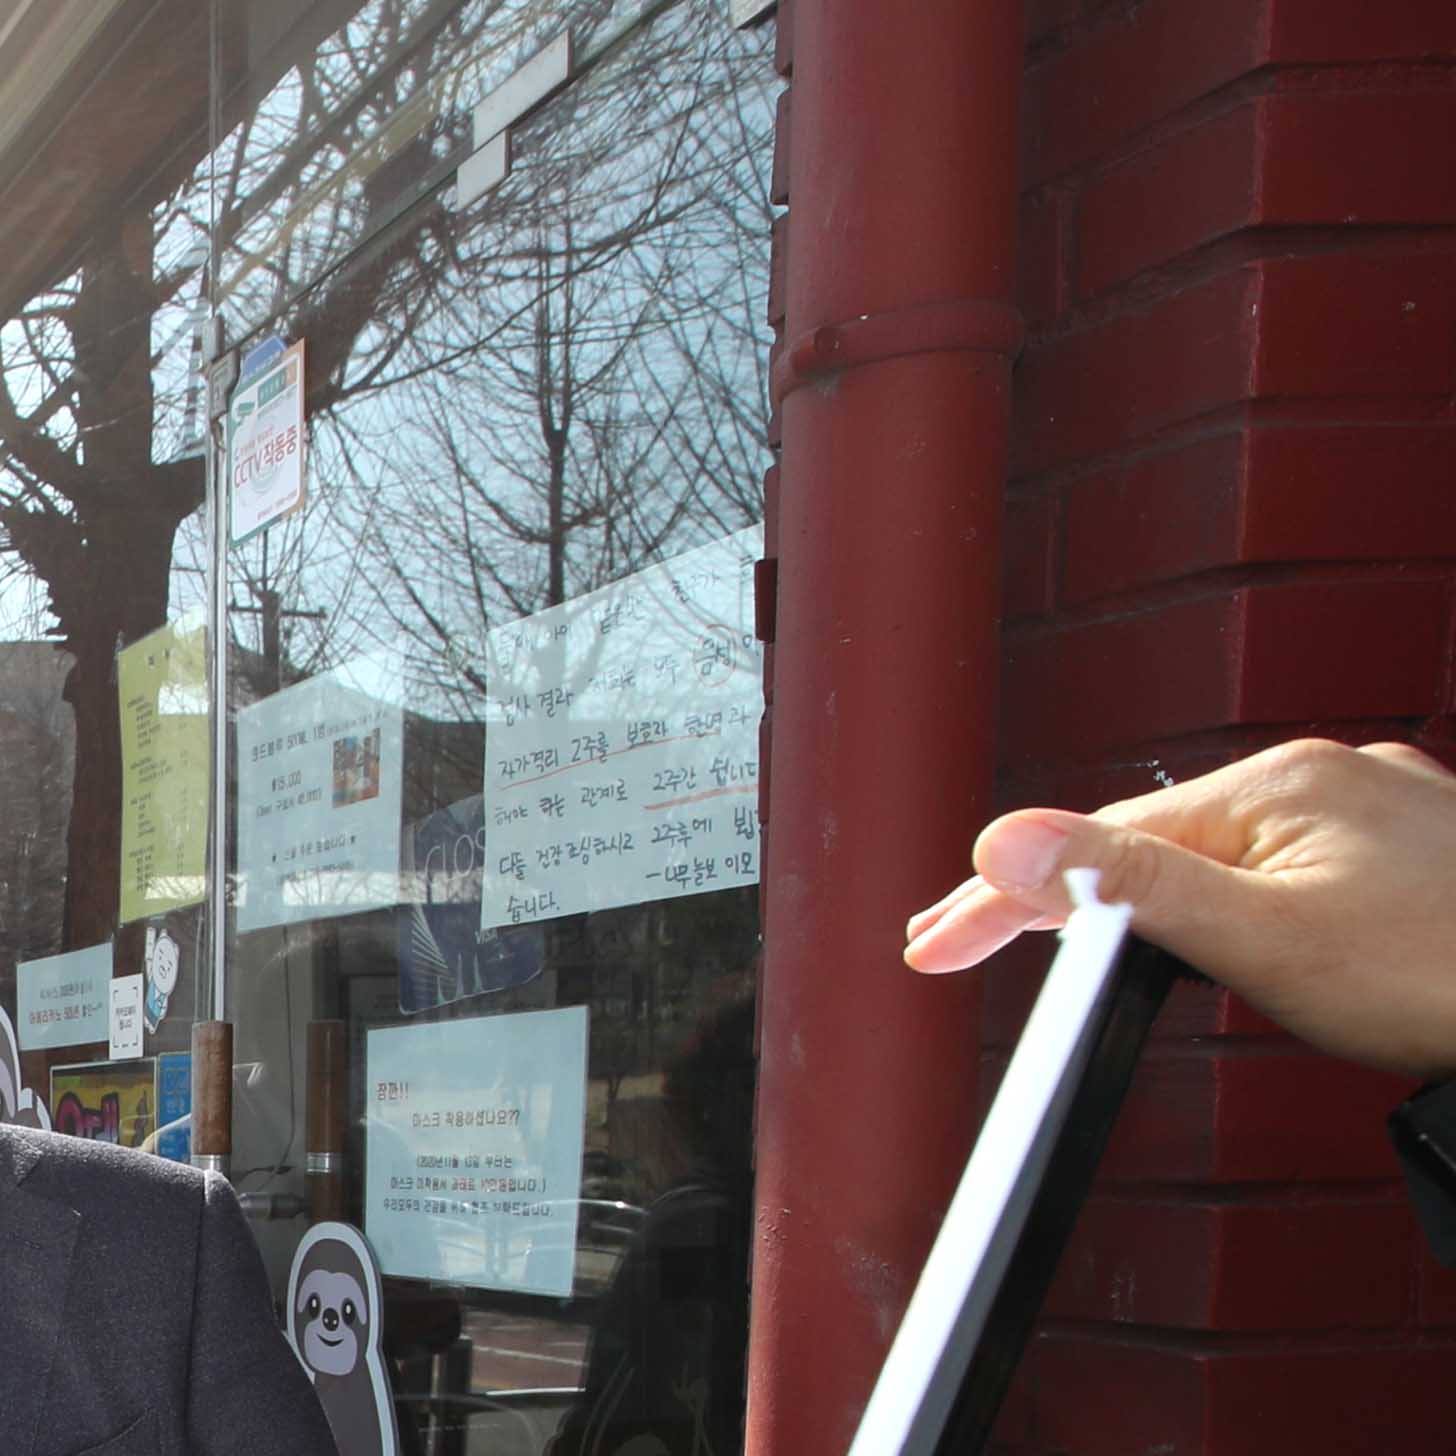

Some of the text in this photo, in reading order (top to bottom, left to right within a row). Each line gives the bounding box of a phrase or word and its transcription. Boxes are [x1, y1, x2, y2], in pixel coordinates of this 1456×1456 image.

[234, 451, 263, 489] CCTV
[264, 425, 298, 466] 작동중
[539, 690, 576, 718] 결과
[497, 747, 559, 779] 자가격리
[571, 731, 609, 763] 2주를
[627, 720, 669, 750] 보호자
[495, 805, 528, 826] 해야
[581, 778, 629, 805] 관계로
[652, 766, 697, 792] 2주간
[499, 855, 527, 881] 다들
[733, 805, 758, 839] 뵙
[506, 891, 561, 923] 습니다.
[724, 850, 756, 876] 이모
[376, 1082, 409, 1102] 잠깐!!
[412, 1112, 441, 1128] 마스크
[484, 1154, 513, 1169] 부터는
[390, 1177, 413, 1190] 마스크
[452, 1177, 476, 1191] 과태료
